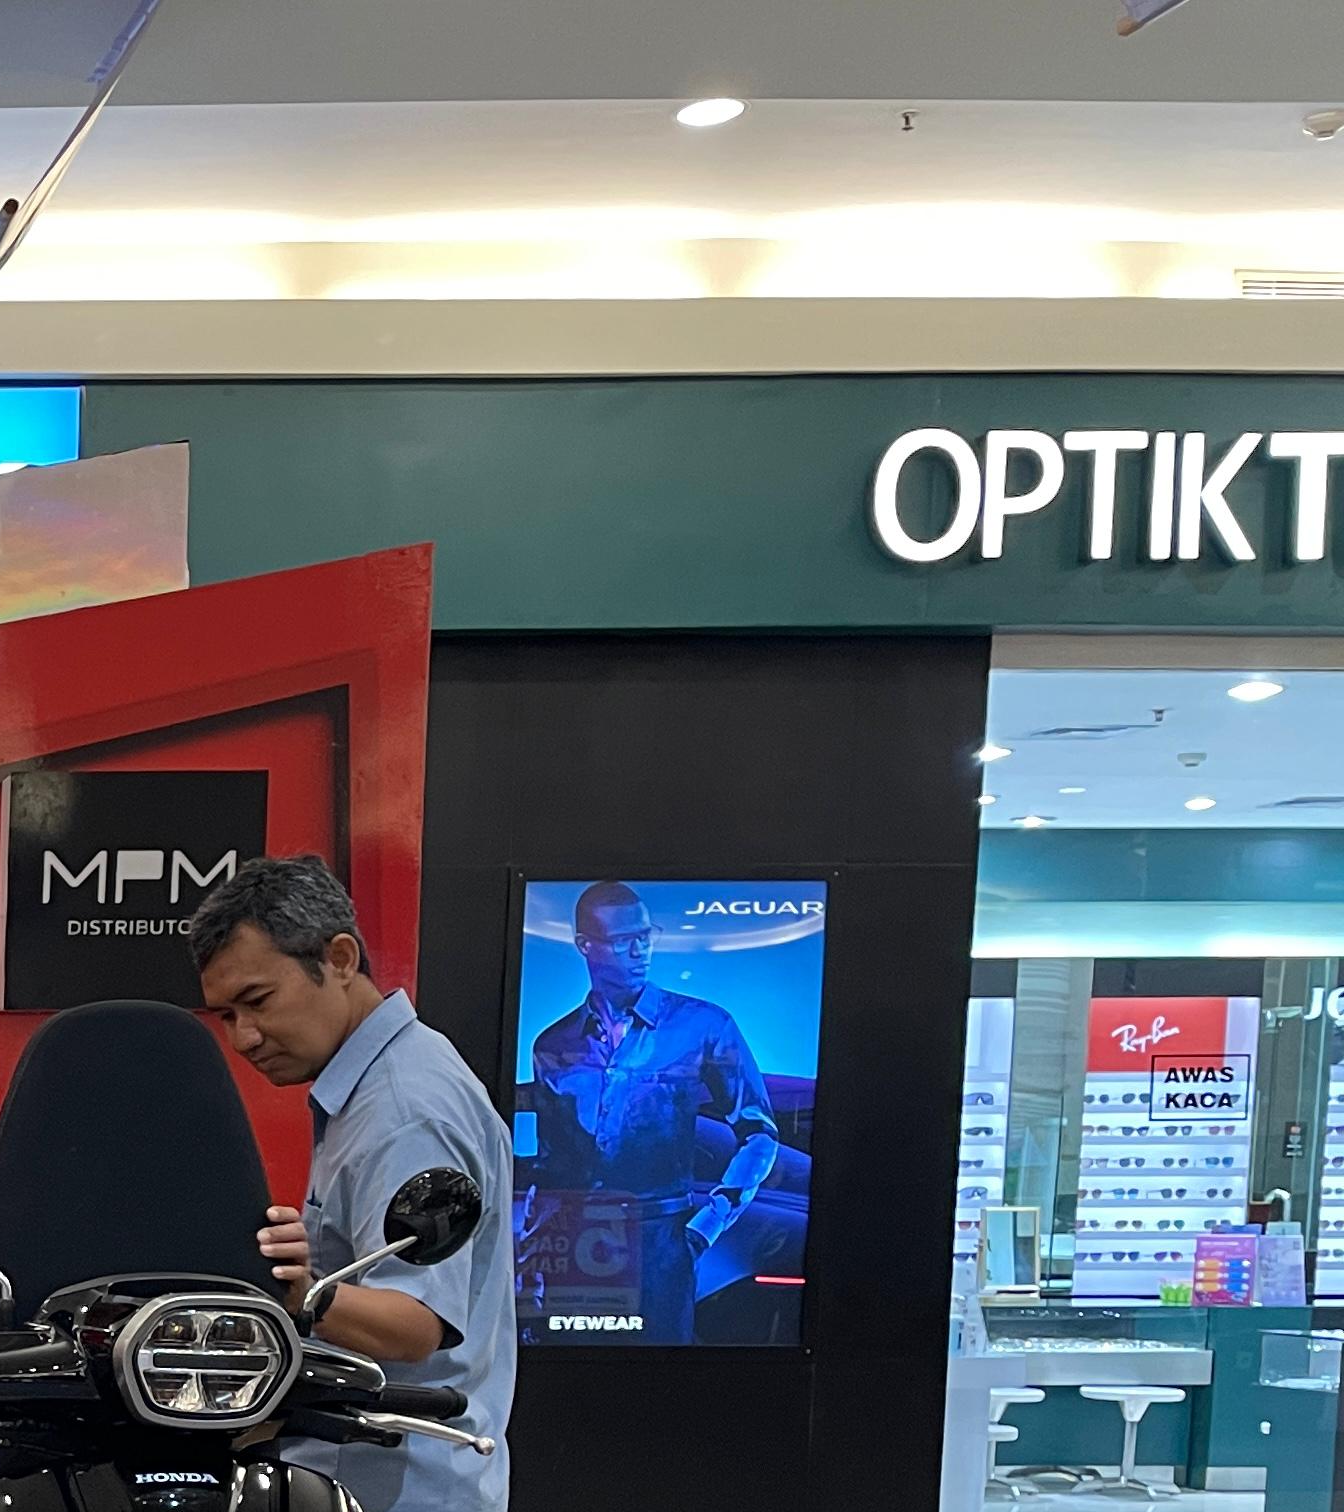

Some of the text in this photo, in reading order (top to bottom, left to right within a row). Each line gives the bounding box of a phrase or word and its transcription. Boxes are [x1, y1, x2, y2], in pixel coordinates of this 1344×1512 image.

[42, 850, 237, 904] MPM
[685, 901, 824, 915] JAGUAR
[67, 919, 192, 936] DISTRIBUTO
[1164, 1066, 1234, 1083] AWAS
[1165, 1092, 1233, 1109] KACA
[548, 1315, 643, 1331] EYEWEAR
[135, 1472, 219, 1484] HONDA
